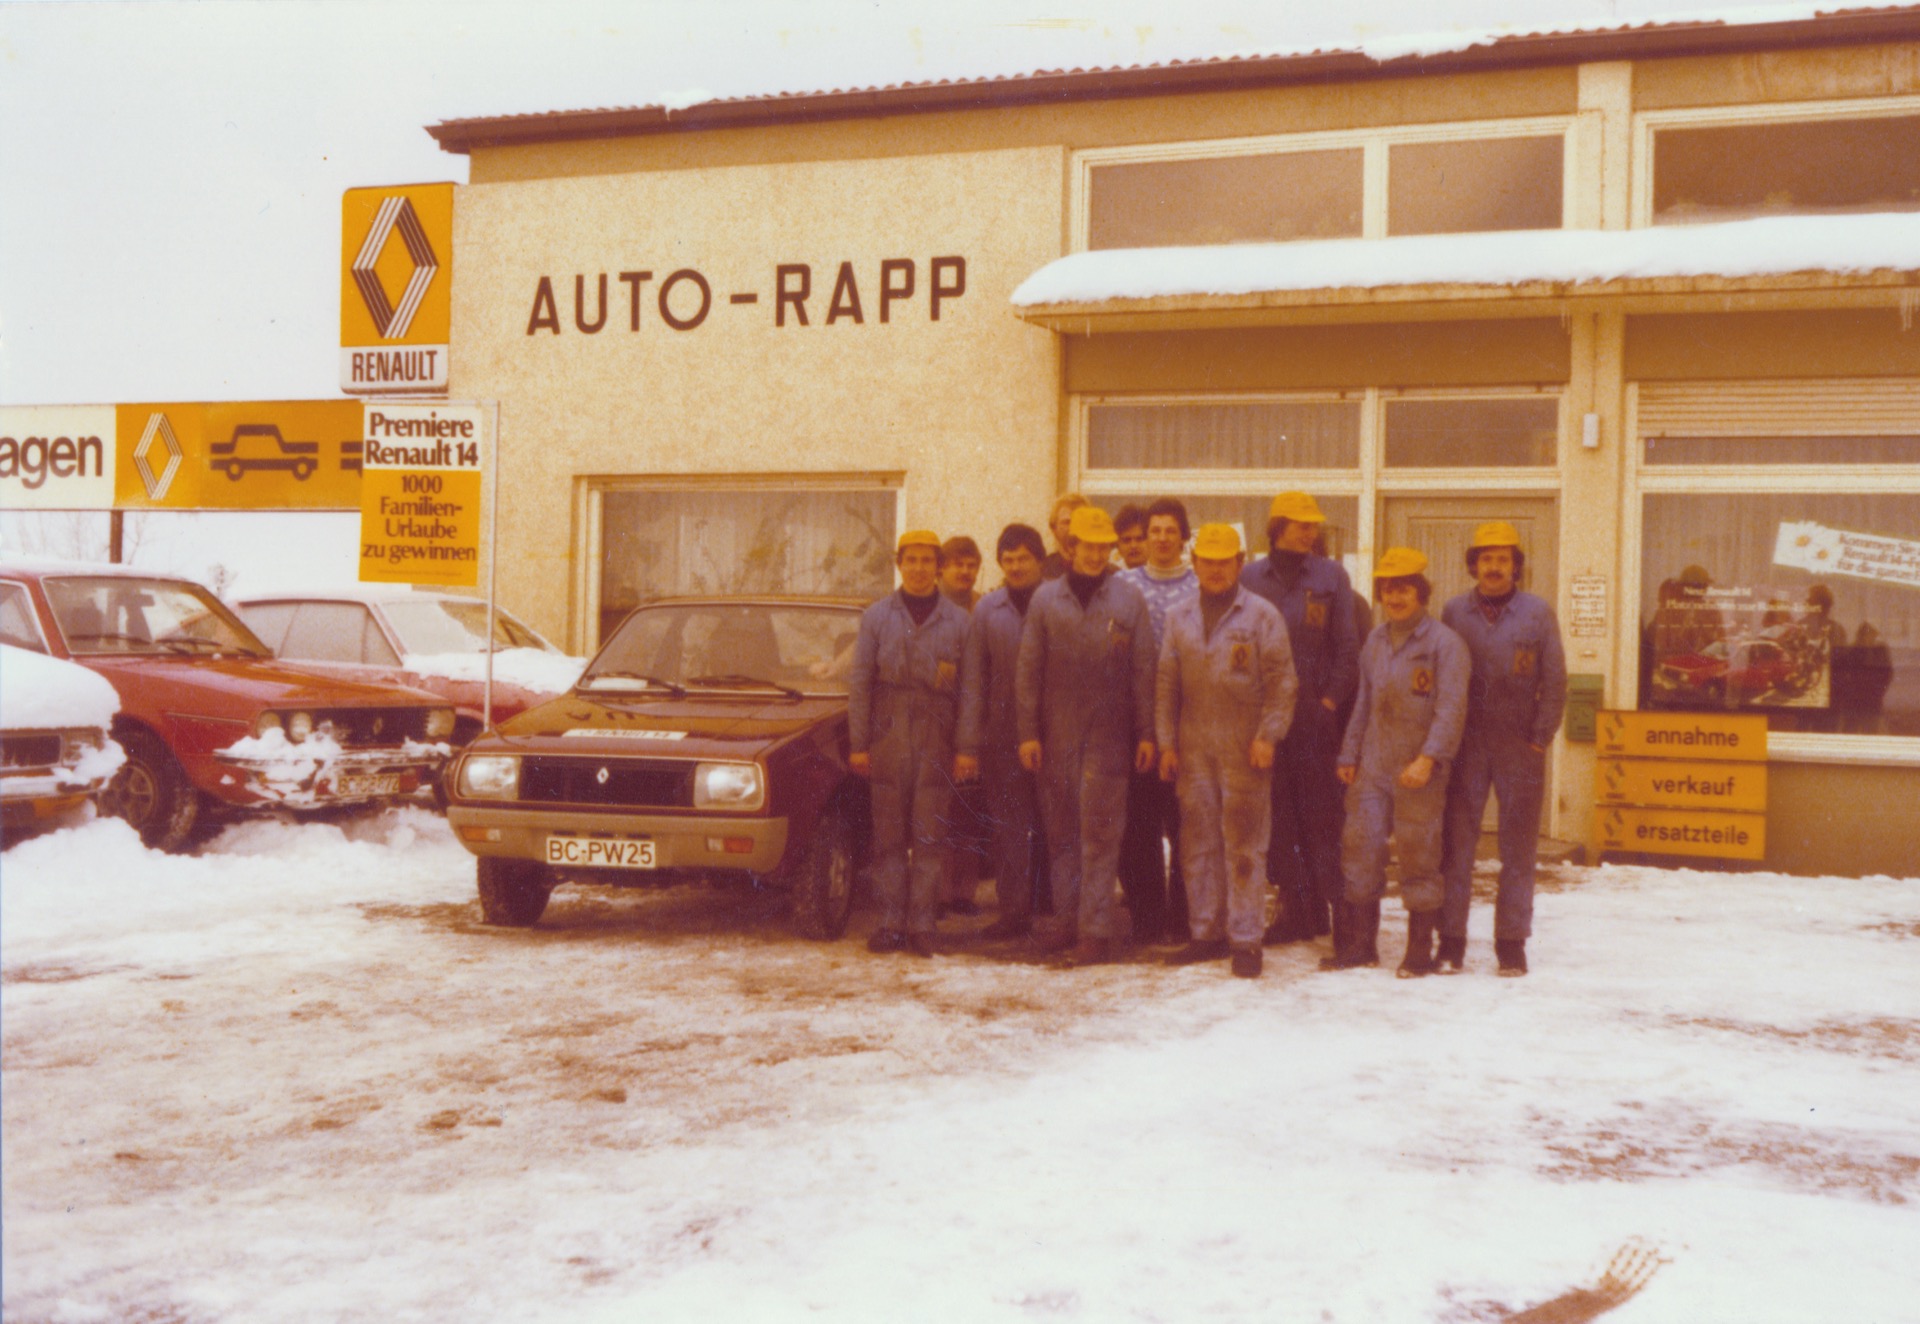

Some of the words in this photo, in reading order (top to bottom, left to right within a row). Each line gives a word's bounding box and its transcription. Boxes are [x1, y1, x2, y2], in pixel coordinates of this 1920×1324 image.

[526, 256, 966, 336] AUTO-RAPP
[352, 350, 438, 384] RENAULT
[370, 411, 474, 438] Premiere
[0, 434, 104, 490] agen
[365, 439, 452, 466] Renault
[455, 442, 479, 466] 14
[402, 474, 443, 494] 1000
[380, 496, 463, 517] Familien-
[385, 518, 457, 539] Urlaube
[362, 543, 386, 558] zu
[388, 540, 476, 564] gewinnen
[1646, 725, 1740, 747] annahme
[1652, 775, 1736, 796] verkauf
[1636, 824, 1750, 845] ersatzteile
